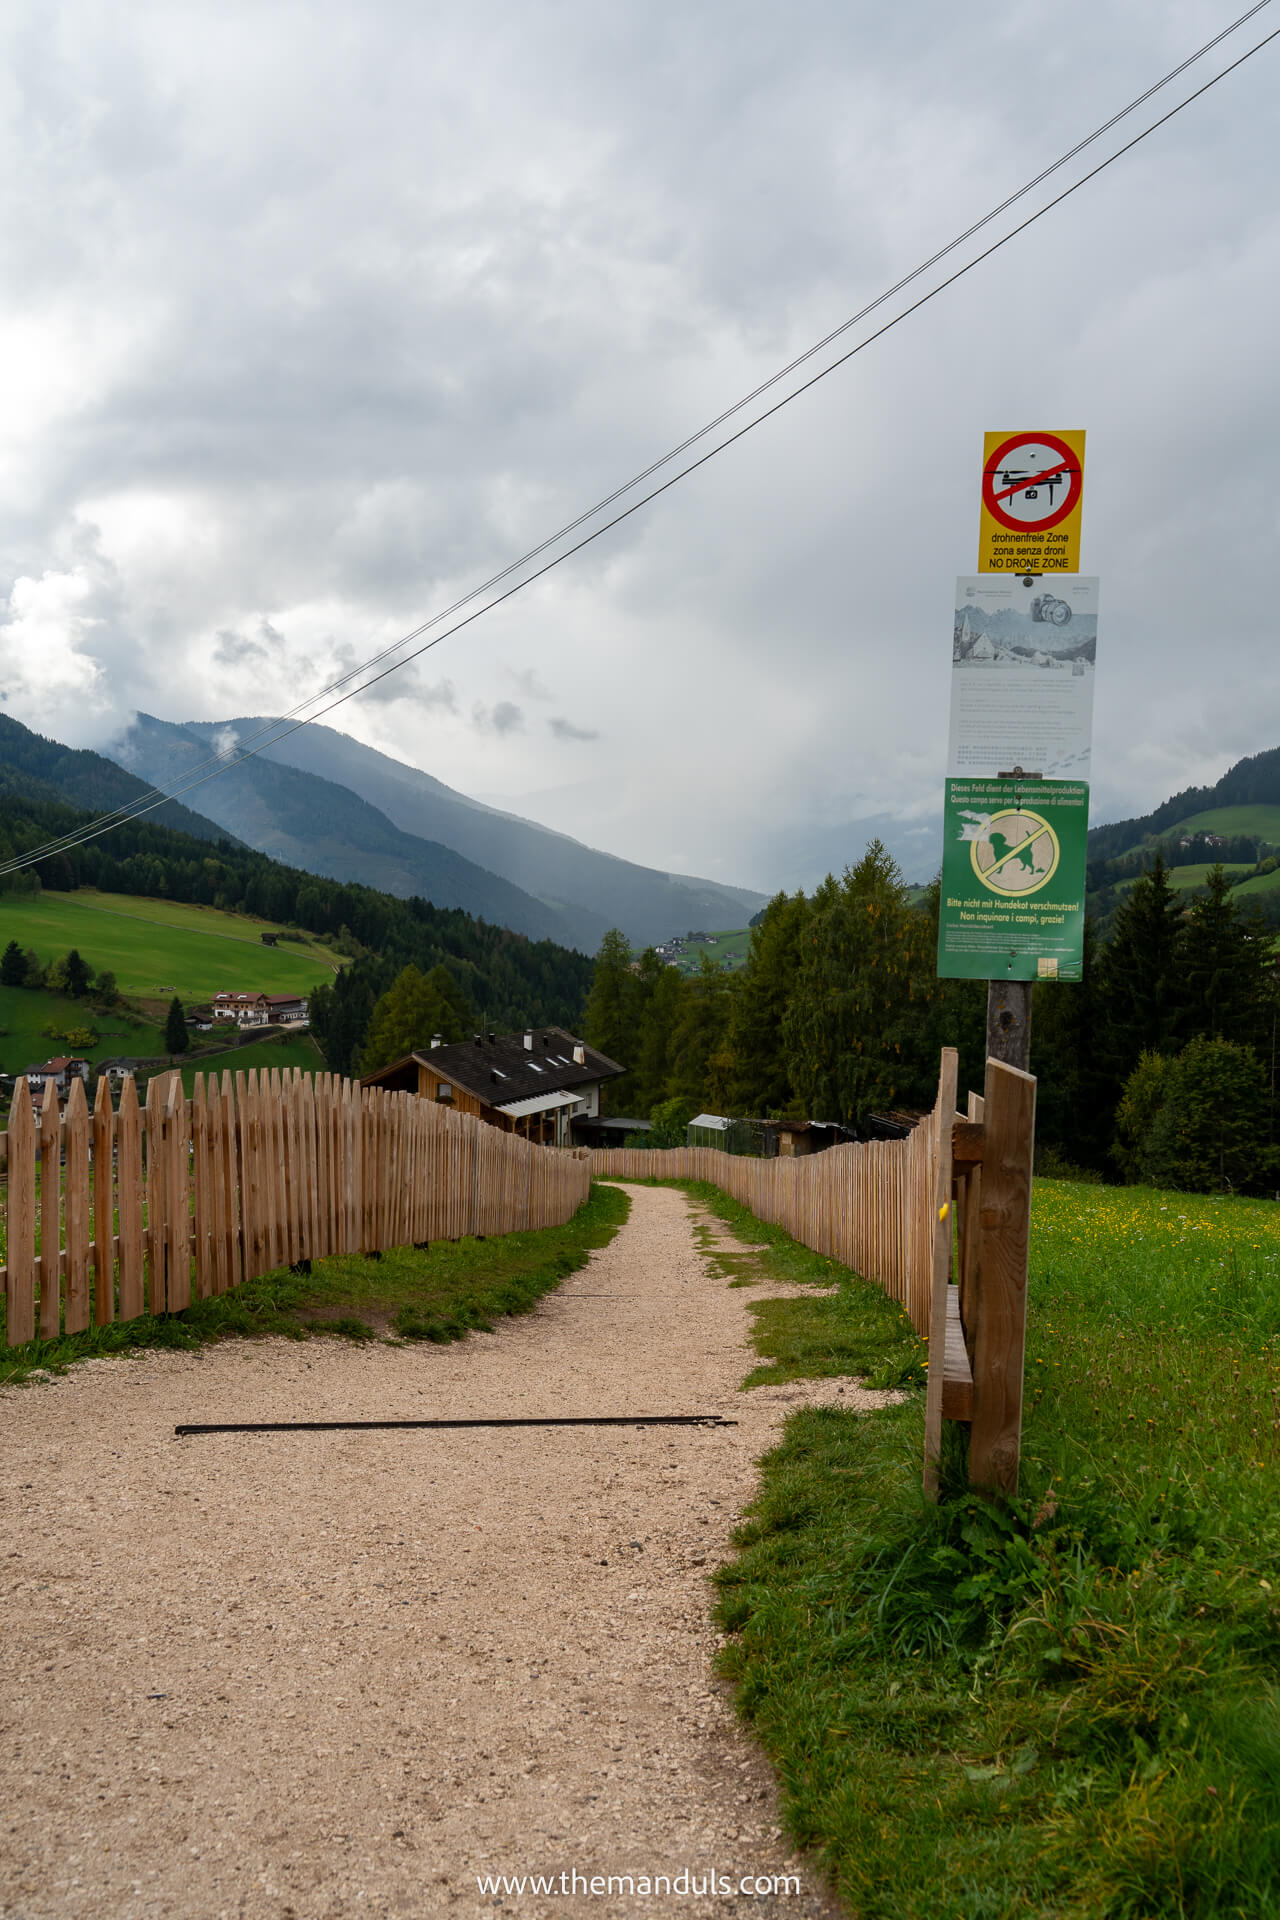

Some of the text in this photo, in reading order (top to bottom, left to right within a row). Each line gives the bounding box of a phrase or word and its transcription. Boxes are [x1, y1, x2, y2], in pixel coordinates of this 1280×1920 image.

[992, 533, 1069, 542] drohnenfreie Zone
[993, 545, 1065, 555] zona senza droni
[989, 559, 1069, 568] NO DRONE ZONE
[951, 784, 970, 792] Dieses
[972, 784, 985, 792] Feld
[1003, 784, 1013, 793] der
[947, 898, 1079, 911] Bitte nicht mit Hundekot verschmutzen!
[960, 912, 975, 920] Non
[977, 912, 1009, 923] inquinare
[1016, 914, 1038, 925] campi,
[1041, 915, 1064, 925] grazie!
